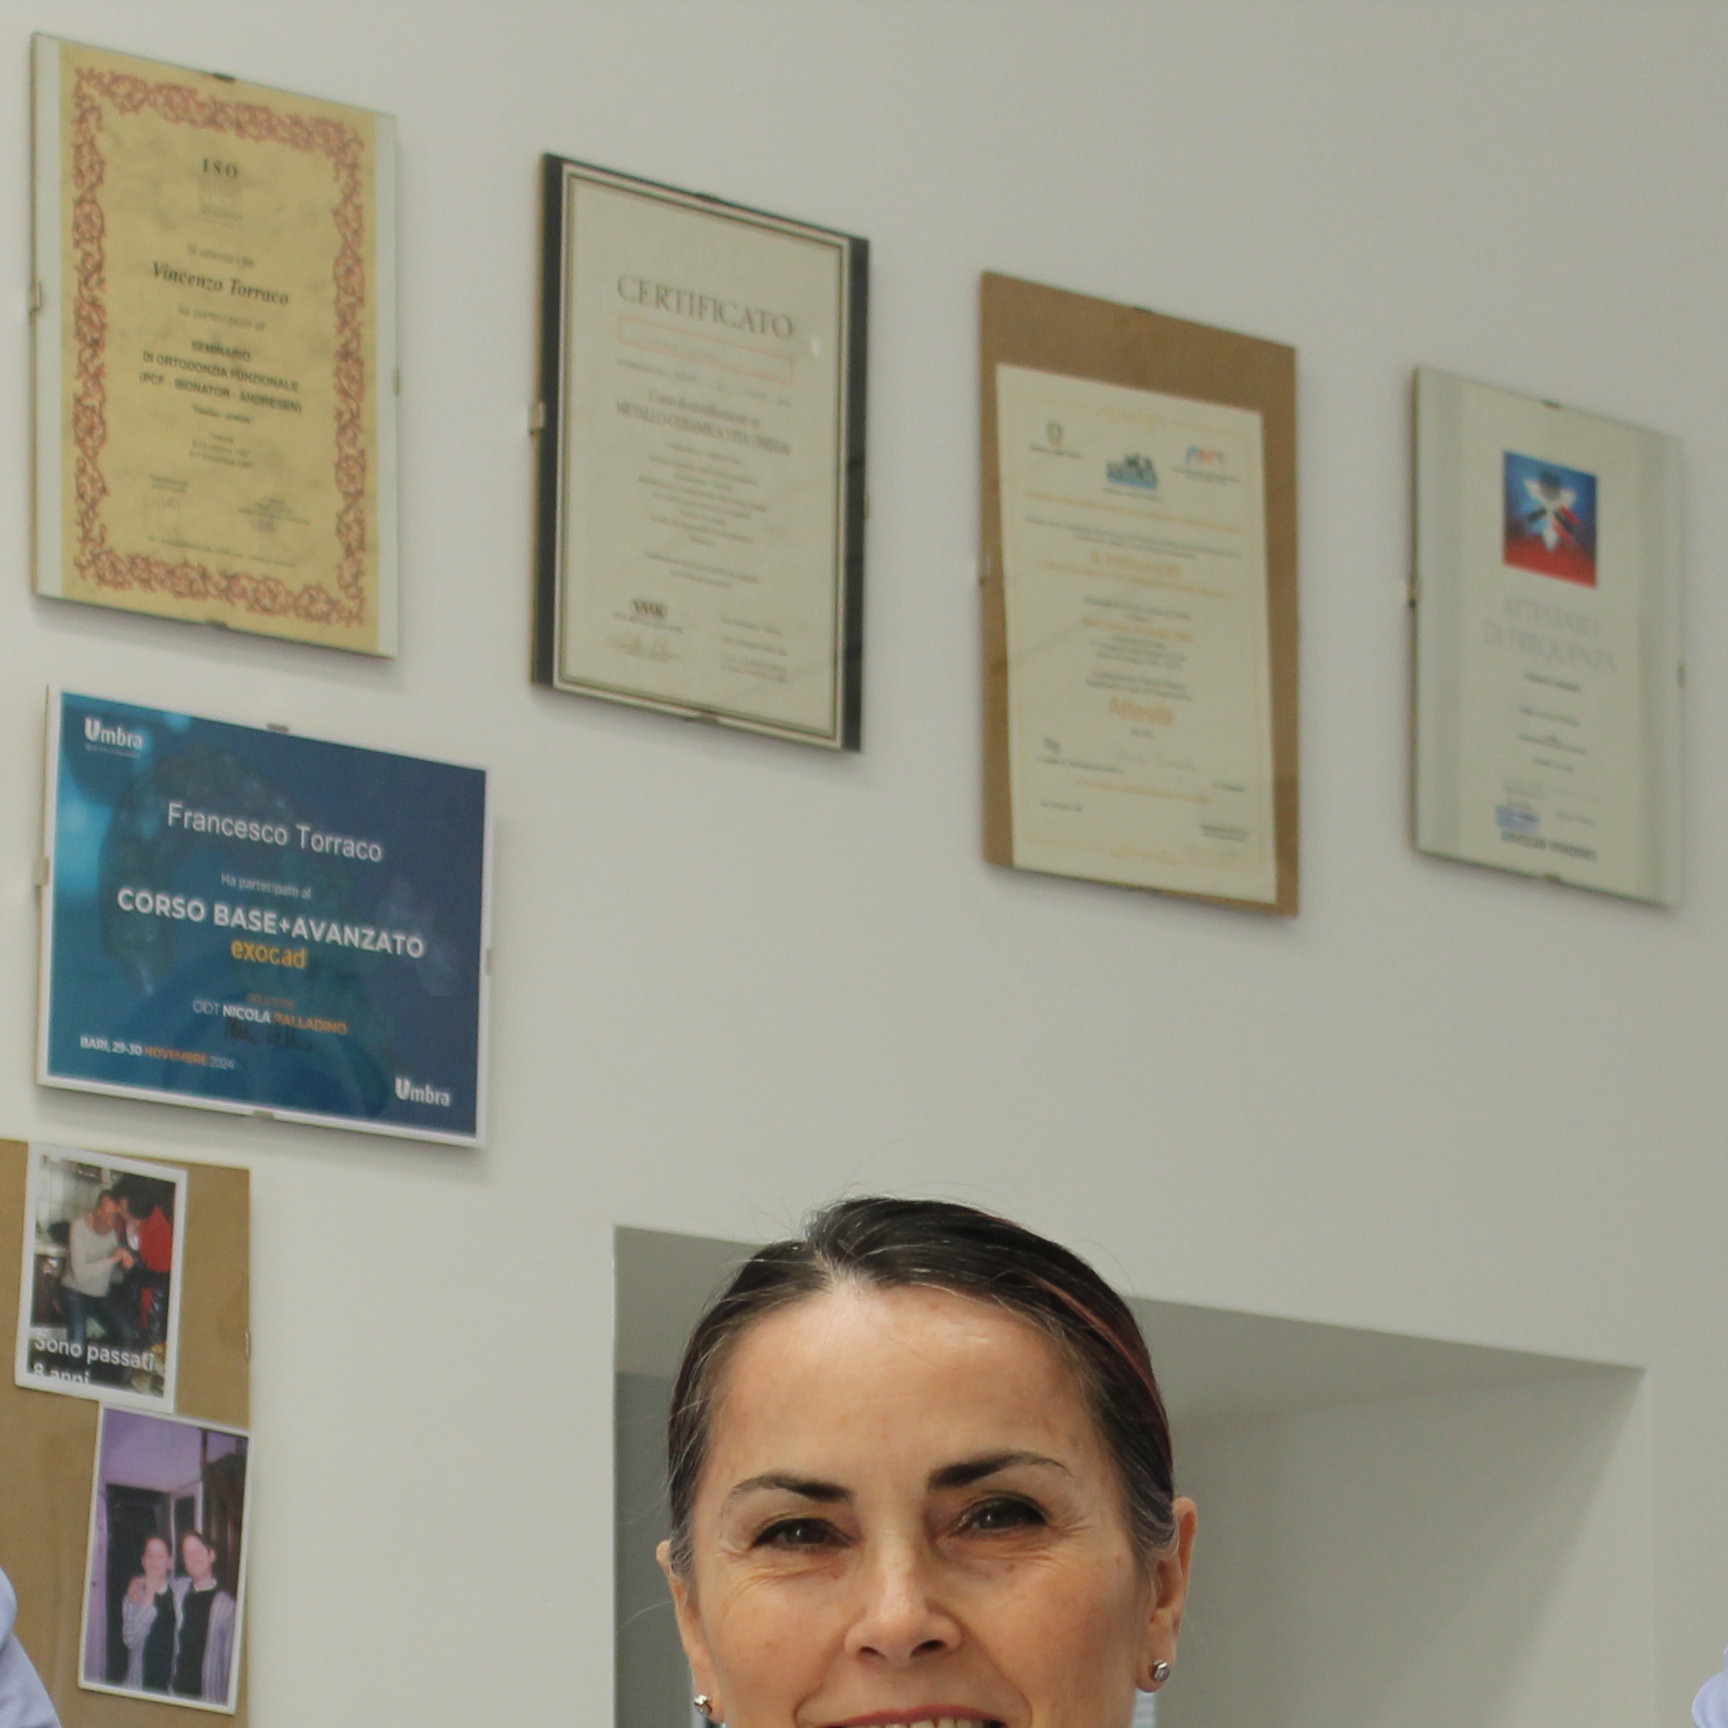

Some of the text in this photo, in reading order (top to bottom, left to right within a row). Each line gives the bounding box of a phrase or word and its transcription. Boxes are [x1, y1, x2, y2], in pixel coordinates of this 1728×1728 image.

[151, 260, 289, 306] Vincenzo Torraco
[616, 274, 794, 341] CERTIFICATO
[84, 716, 144, 750] Umbra
[167, 801, 384, 864] Francesco Torraco
[220, 872, 237, 888] Ha
[238, 876, 300, 900] partecipato
[117, 887, 426, 960] CORSO BASE+AVANZATO
[229, 939, 309, 970] exocad
[222, 1003, 272, 1025] NICOLA
[394, 1076, 452, 1109] Umbra
[86, 1345, 155, 1372] passati
